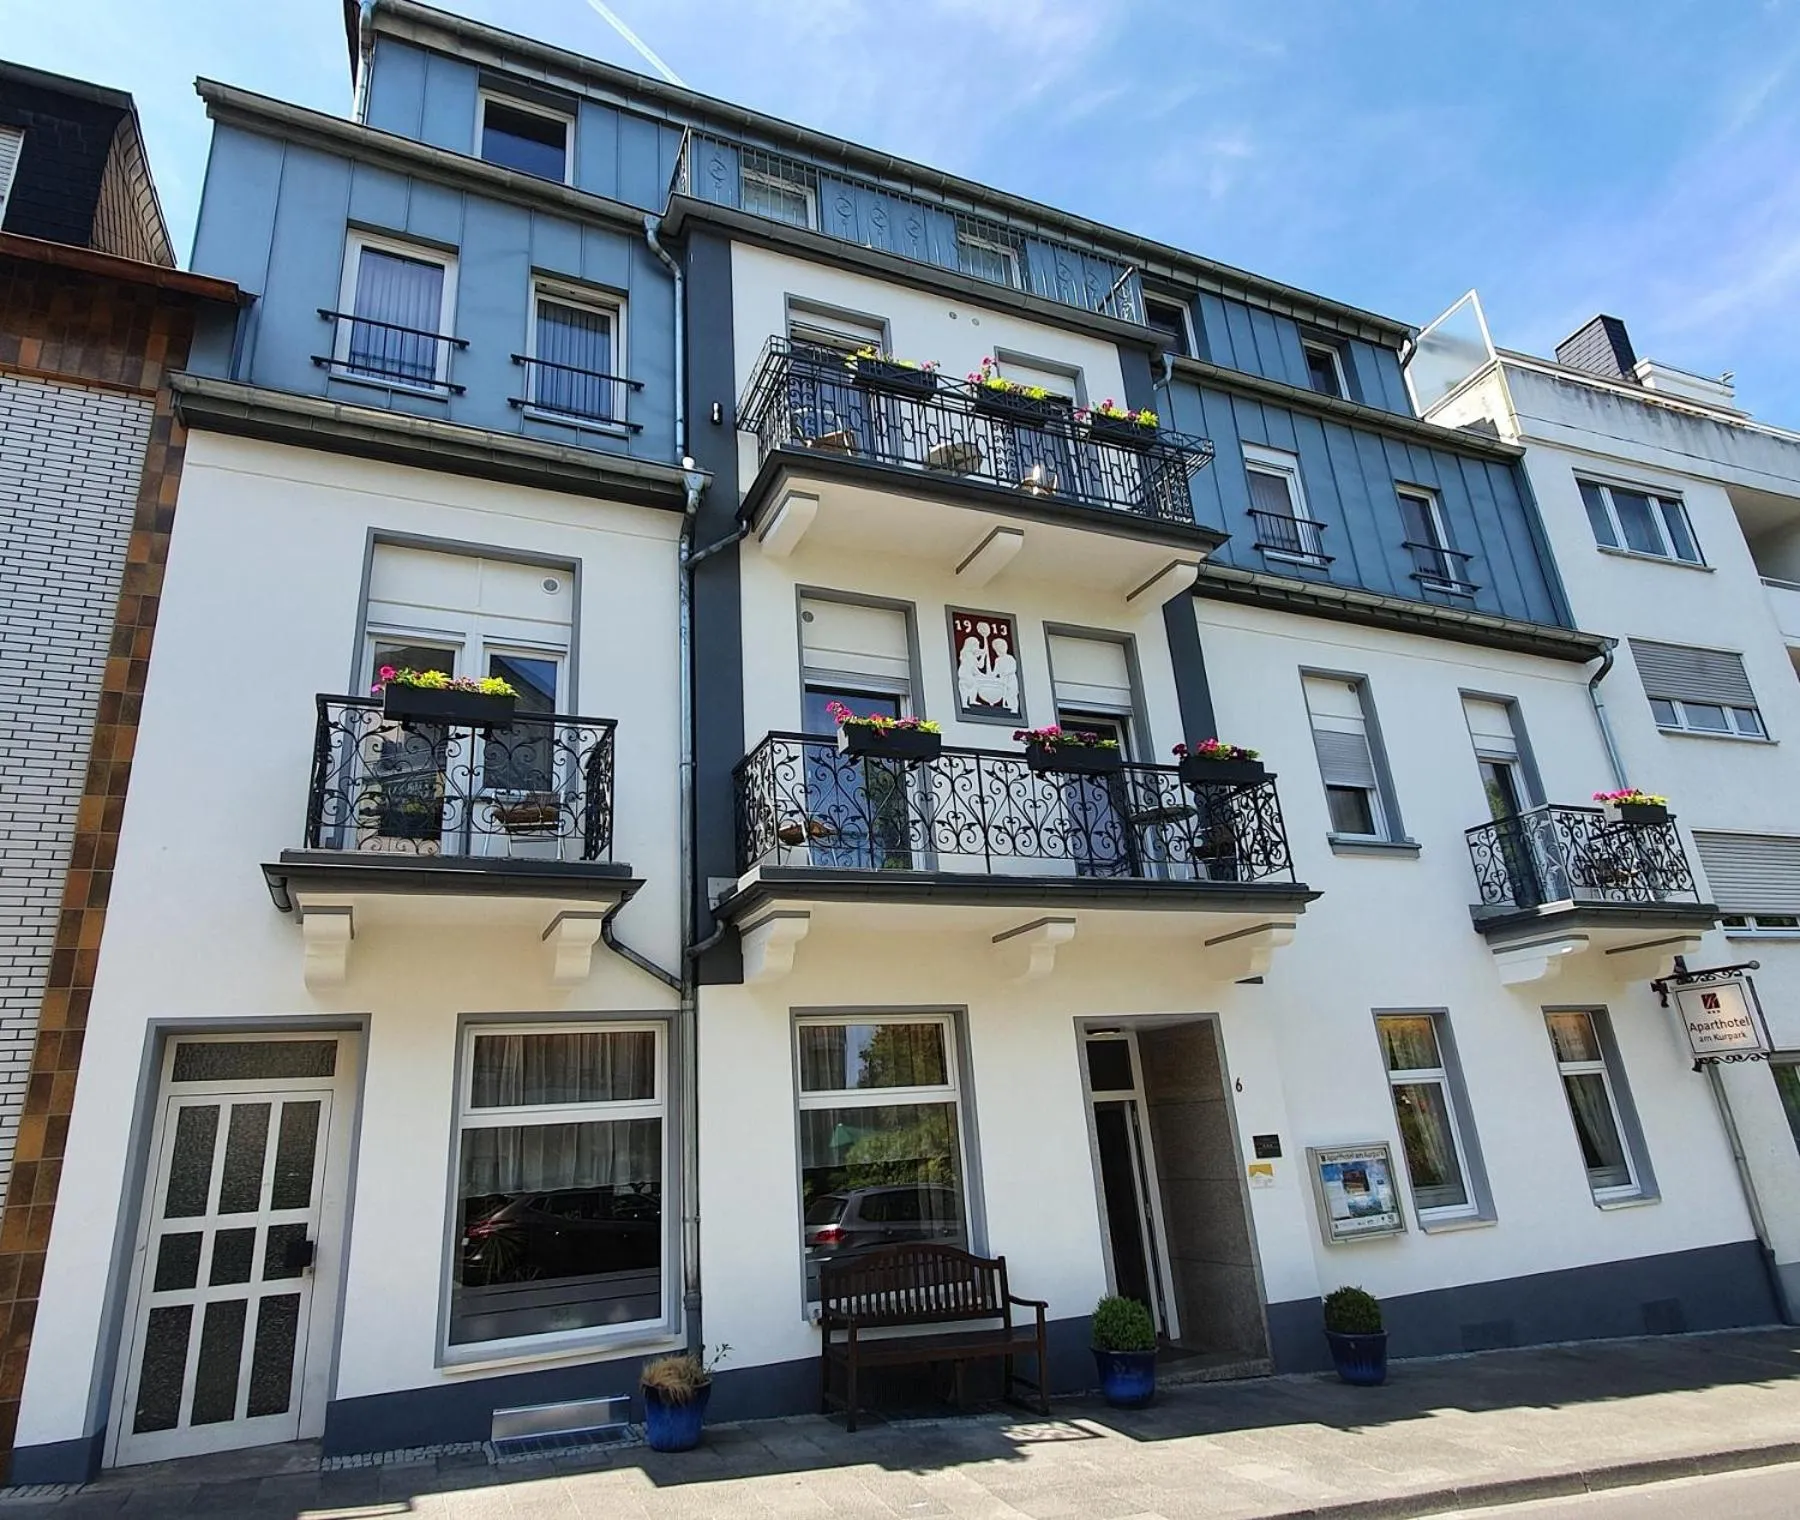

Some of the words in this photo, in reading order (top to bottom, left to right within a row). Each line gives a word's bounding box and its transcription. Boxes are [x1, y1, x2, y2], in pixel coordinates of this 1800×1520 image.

[1689, 1016, 1751, 1033] Aparthotel
[1713, 1031, 1747, 1042] Kurpark
[1235, 1077, 1243, 1092] 6
